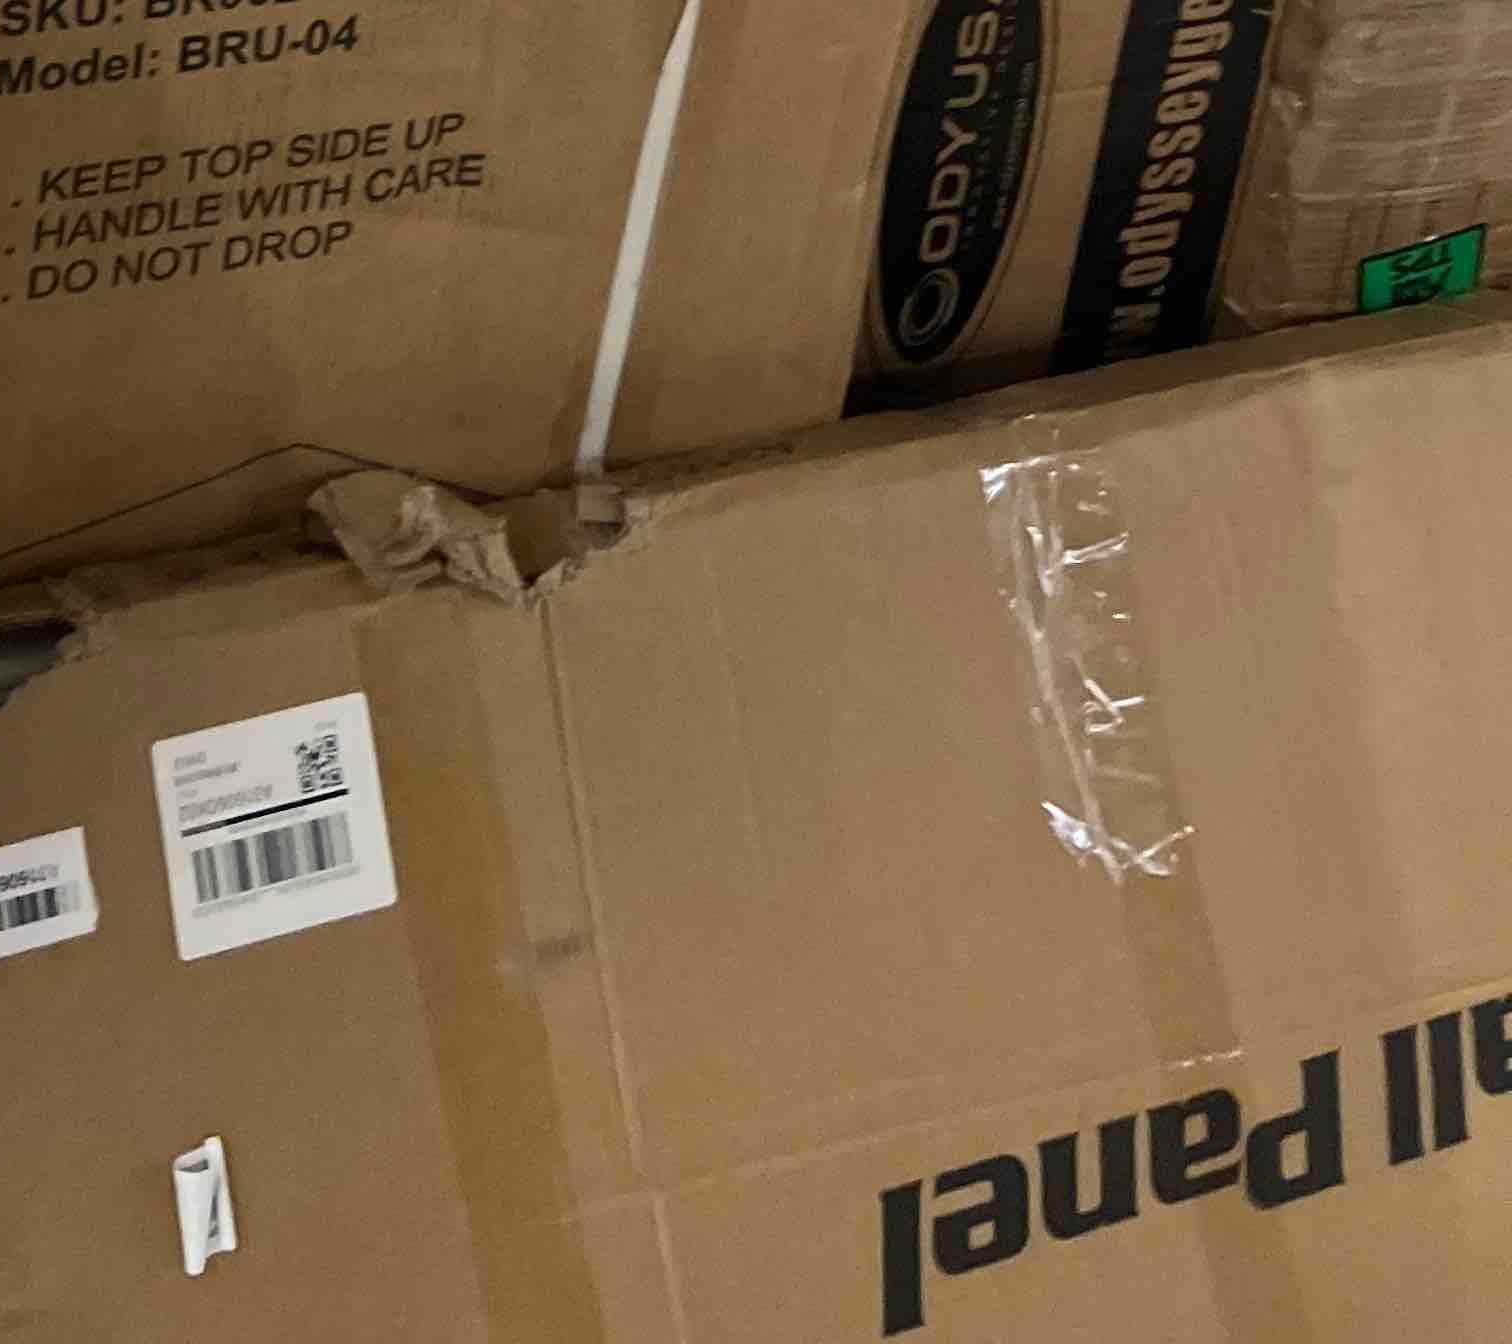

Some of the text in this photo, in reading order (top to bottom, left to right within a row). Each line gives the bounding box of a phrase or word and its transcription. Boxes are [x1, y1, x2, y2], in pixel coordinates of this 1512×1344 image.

[177, 15, 359, 75] BRU-04
[31, 153, 487, 253] HANDLE WITH CARE
[38, 112, 466, 205] KEEP TOP SIDE UP
[26, 221, 355, 300] DO NOT DROP
[879, 1047, 1346, 1337] Panel
